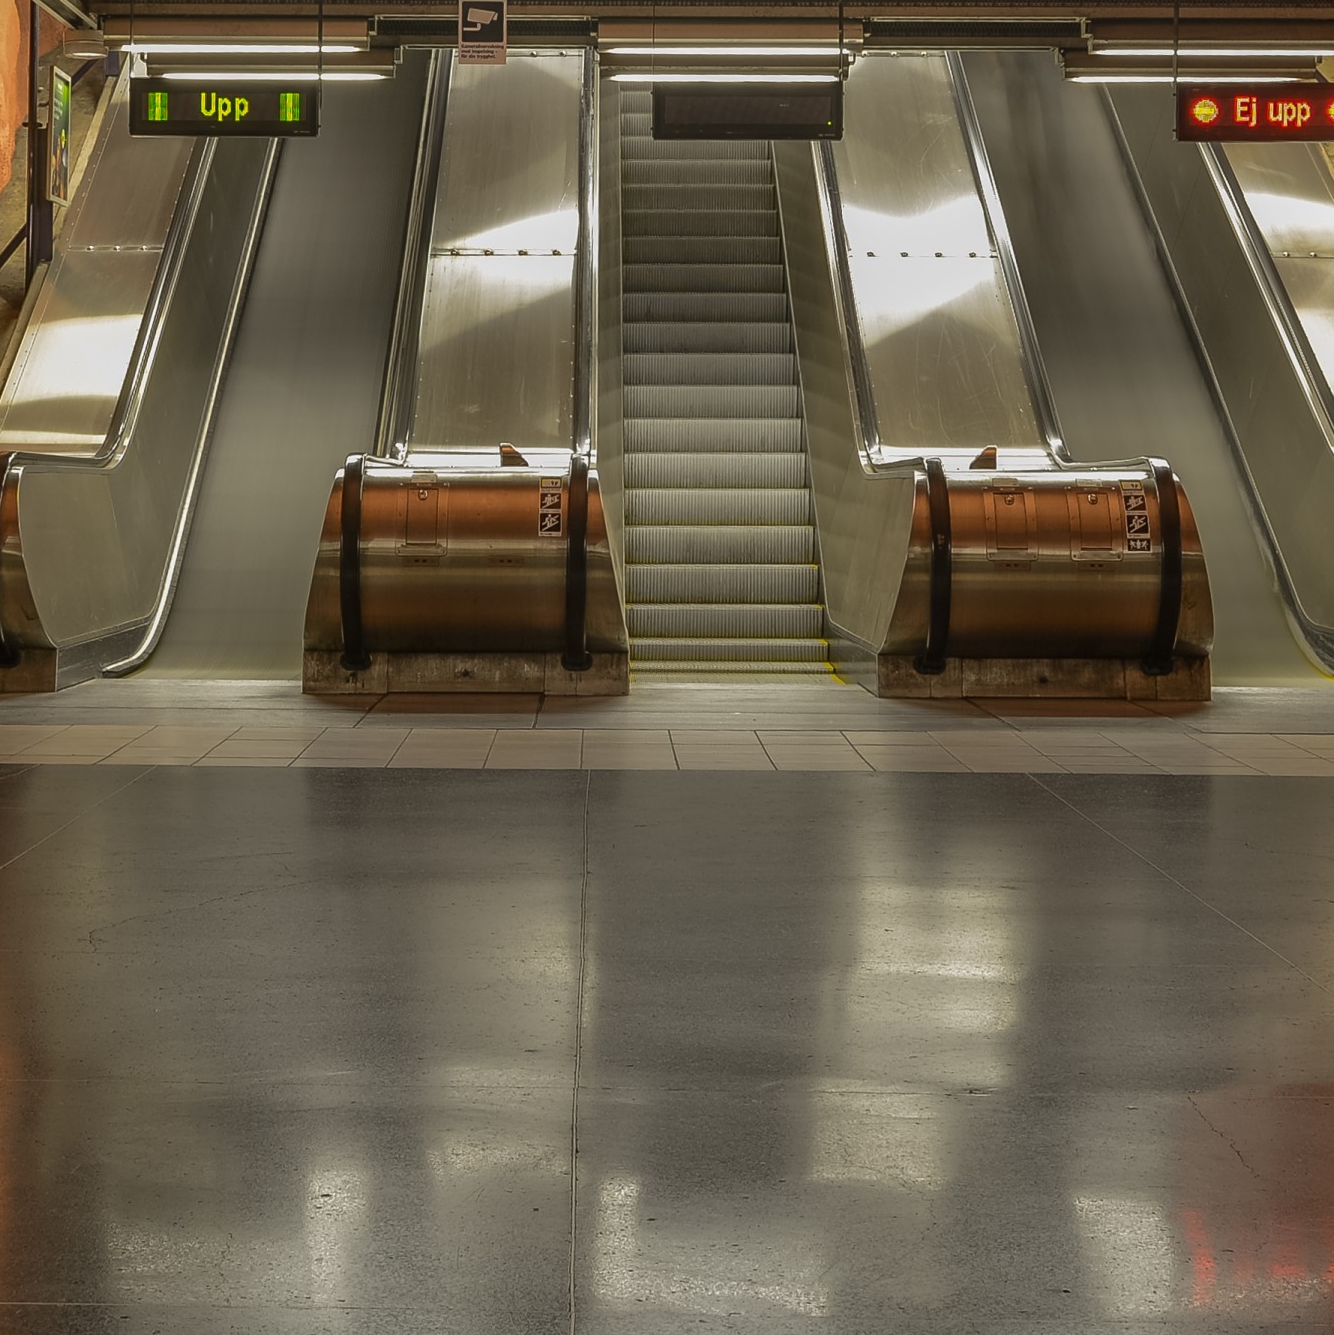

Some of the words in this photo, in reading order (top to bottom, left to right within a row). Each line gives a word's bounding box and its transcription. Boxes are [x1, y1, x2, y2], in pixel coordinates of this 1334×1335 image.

[200, 92, 249, 122] Upp
[1235, 96, 1257, 127] Ej
[1268, 101, 1311, 127] upp
